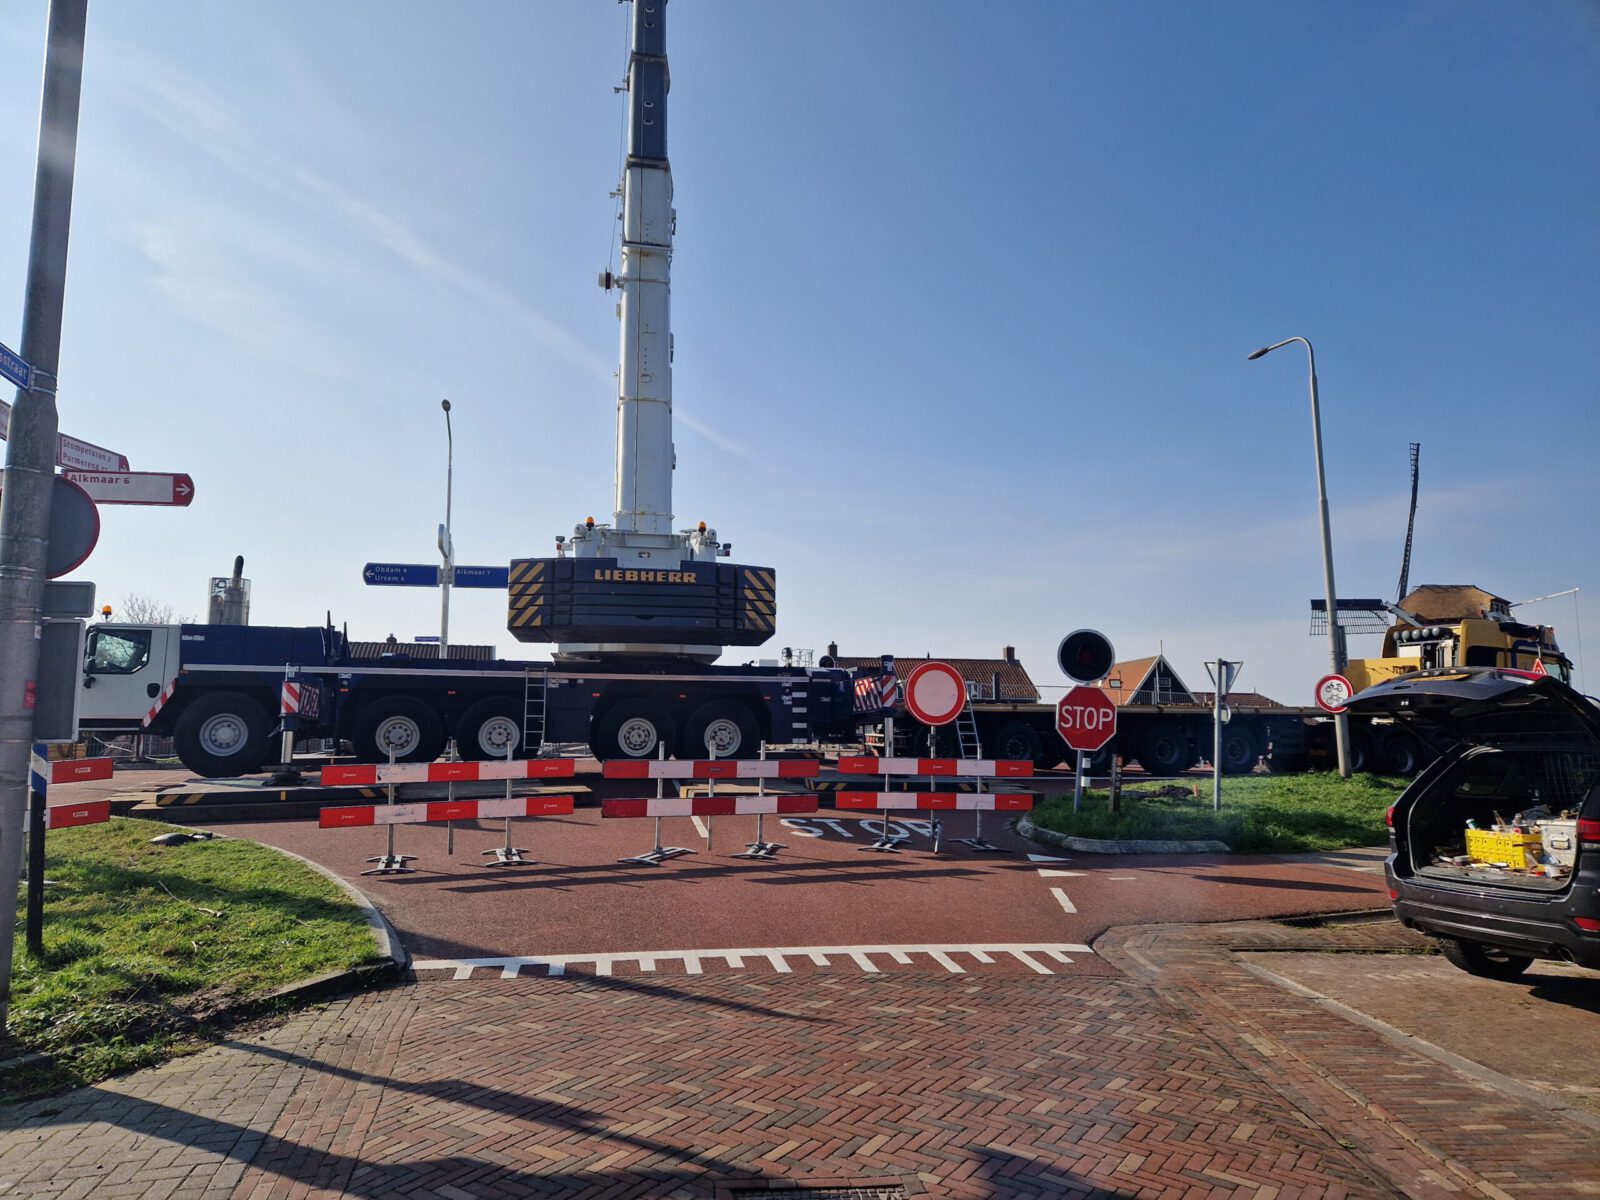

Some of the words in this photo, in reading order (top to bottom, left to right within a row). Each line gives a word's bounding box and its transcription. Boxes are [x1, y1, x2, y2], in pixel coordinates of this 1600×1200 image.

[63, 438, 106, 461] Stompetoren
[63, 452, 99, 471] Purmerend
[71, 474, 120, 484] Alkmaar
[456, 568, 485, 576] Alkmaar
[594, 569, 697, 584] LIEBHERR
[1060, 705, 1114, 731] STOP
[780, 818, 937, 840] STOP
